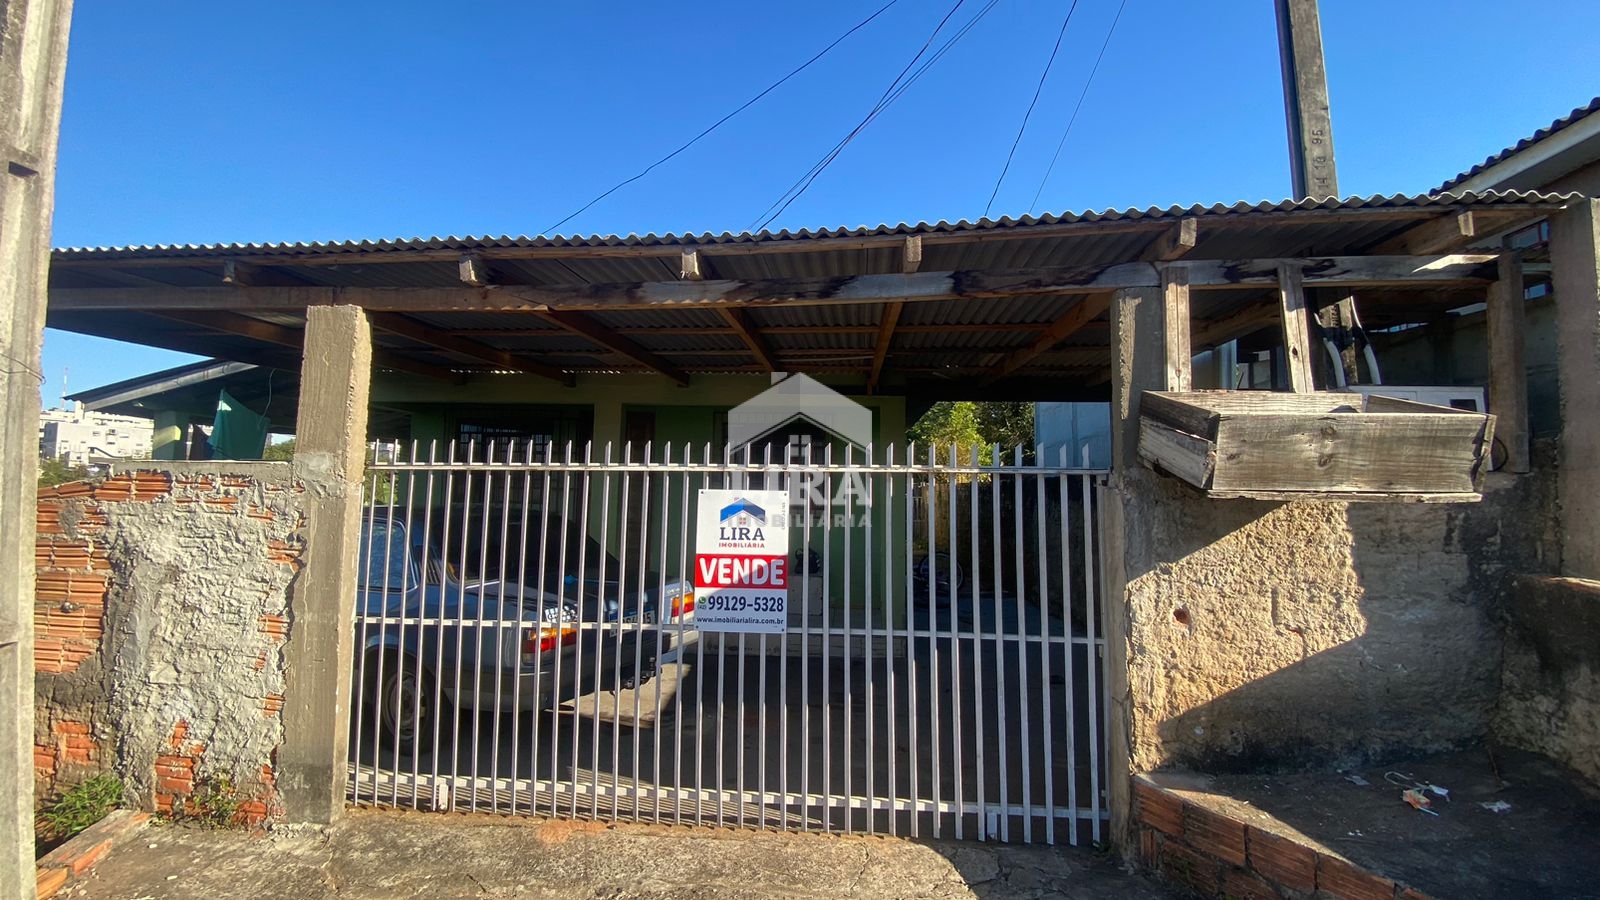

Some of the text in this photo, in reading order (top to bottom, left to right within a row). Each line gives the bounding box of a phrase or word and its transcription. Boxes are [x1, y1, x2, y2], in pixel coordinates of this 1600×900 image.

[719, 527, 765, 541] LIRA
[718, 541, 765, 549] IMOBILIÁRIA
[698, 557, 785, 586] VENDE
[708, 595, 784, 613] 99129-5328
[696, 616, 784, 625] www.imobiliarialira.com.br
